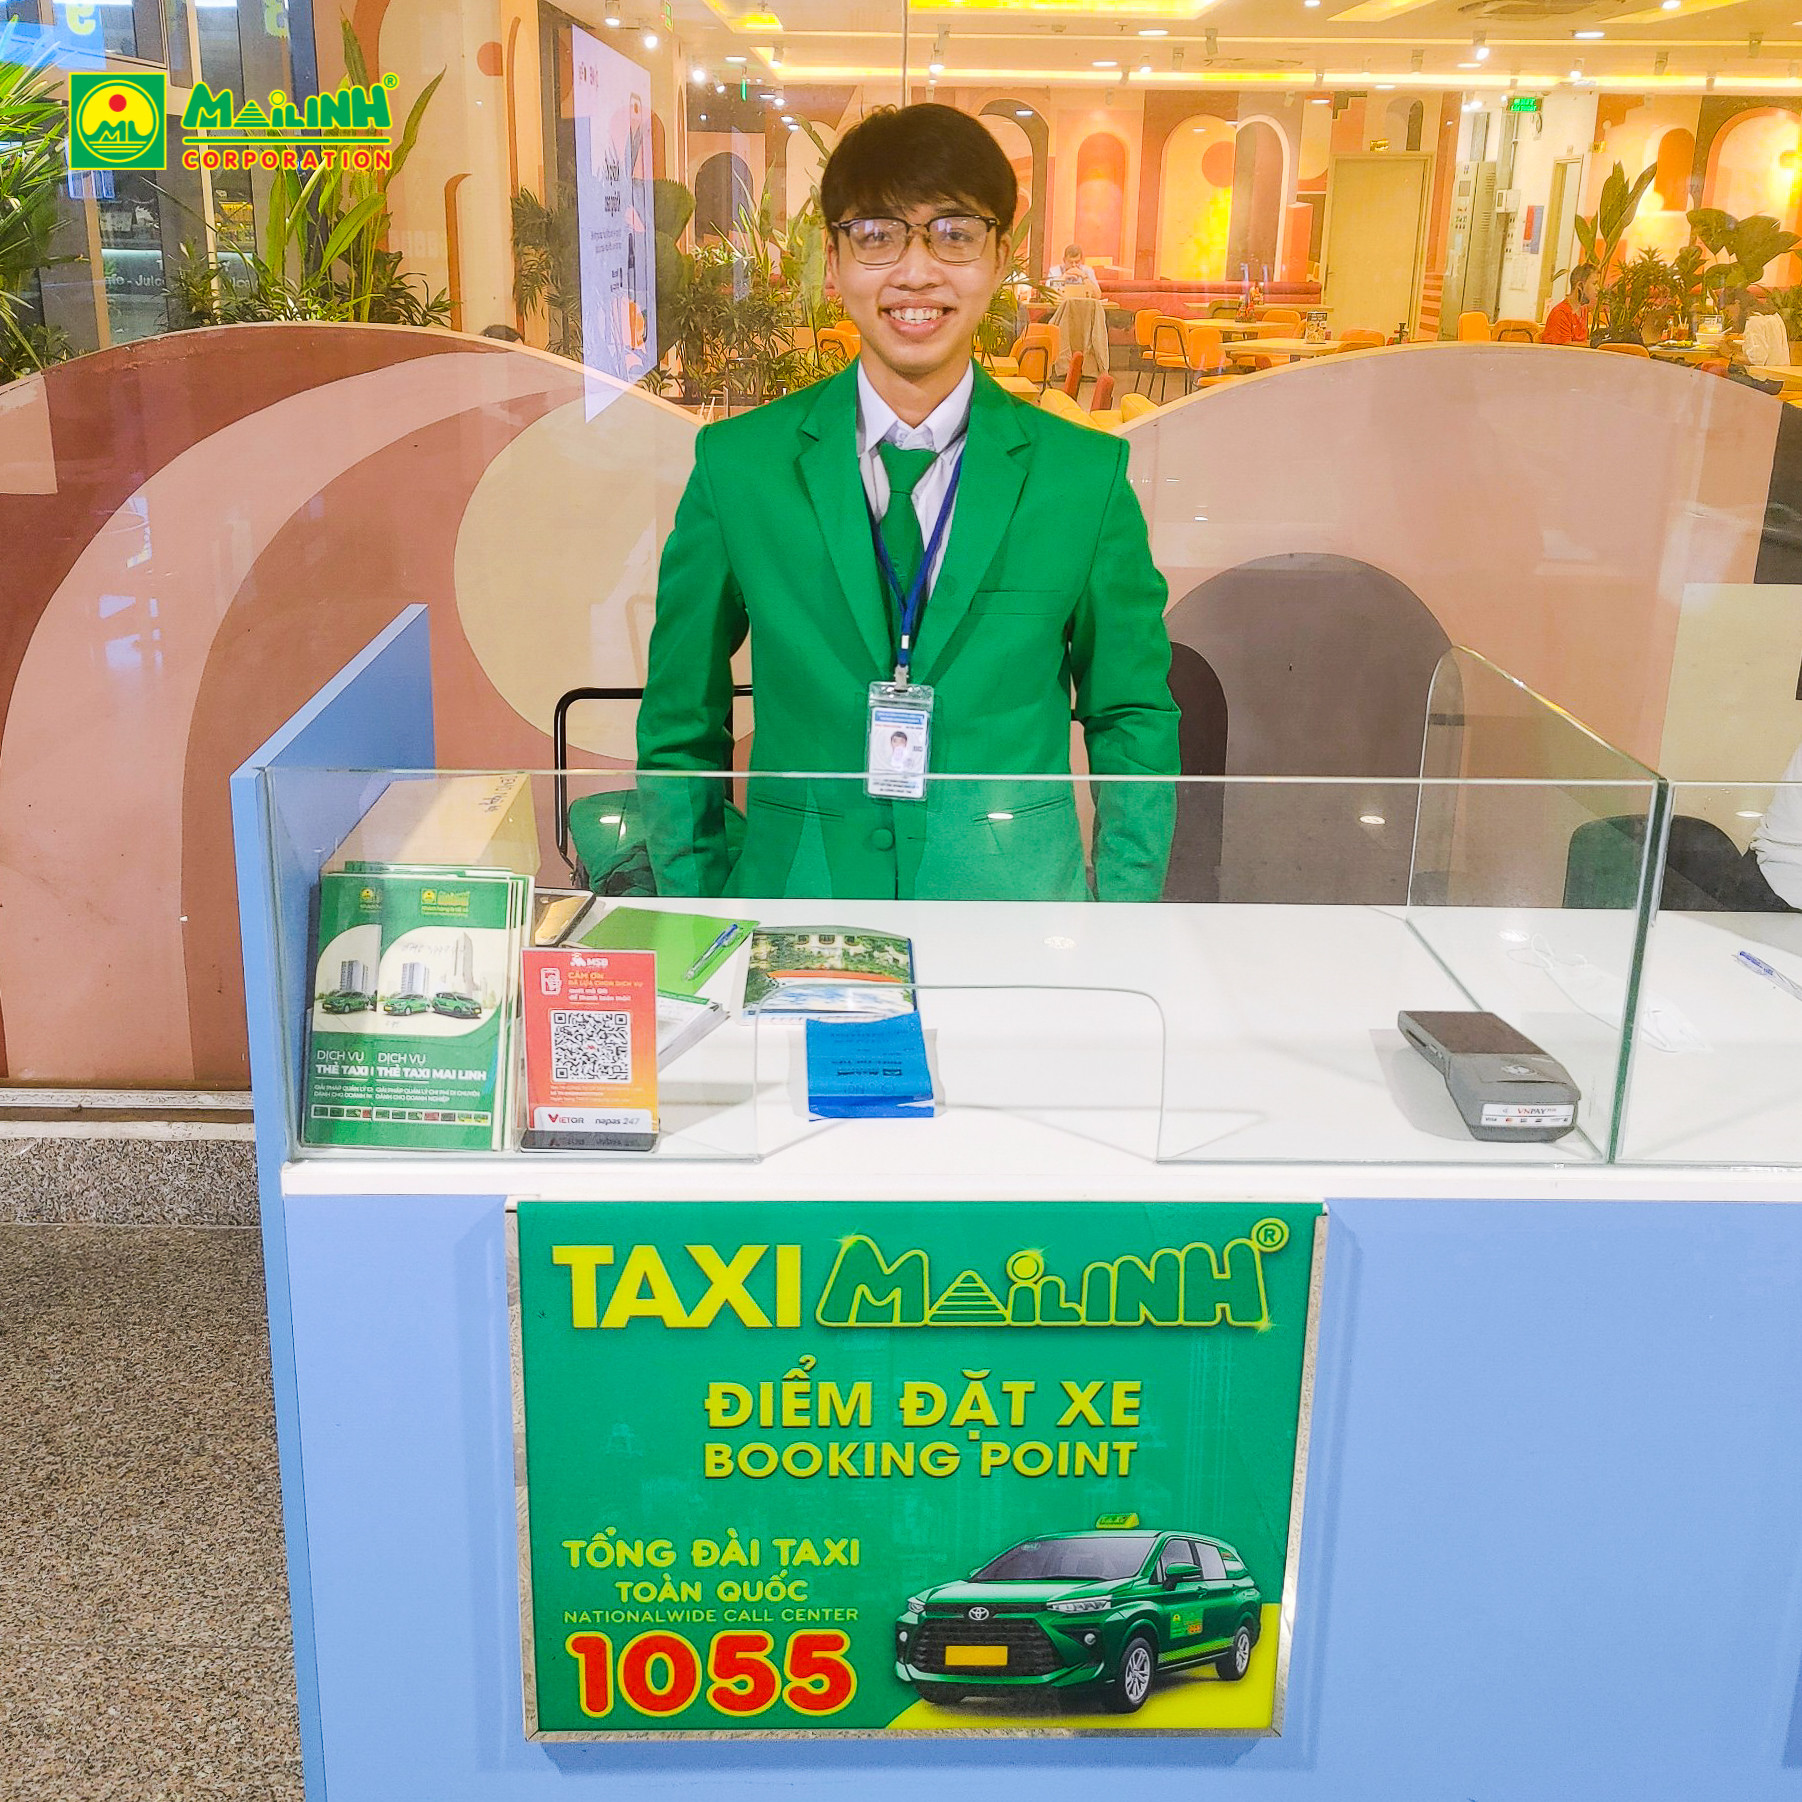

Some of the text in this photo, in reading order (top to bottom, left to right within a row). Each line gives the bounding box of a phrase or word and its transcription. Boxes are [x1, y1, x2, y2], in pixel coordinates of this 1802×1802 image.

[316, 1050, 365, 1064] DỊCH VỤ
[316, 1062, 340, 1074] THẺ
[341, 1064, 369, 1076] TAXI
[378, 1052, 426, 1066] DỊCH VỤ
[376, 1064, 400, 1076] THẺ
[402, 1068, 430, 1078] TAXI
[432, 1069, 457, 1080] MAI
[458, 1070, 487, 1081] LINH
[596, 1117, 620, 1126] napas
[551, 1244, 802, 1329] TAXI
[704, 1354, 1142, 1441] ĐIỂM ĐẶT XE
[704, 1441, 1138, 1479] BOOKING POINT
[691, 1527, 761, 1567] ĐÀI
[772, 1537, 860, 1567] TAXI
[615, 1569, 808, 1603] TOÀN QUỐC
[563, 1608, 859, 1623] NATIONALWIDE CALL CENTER
[565, 1629, 858, 1718] 1055
